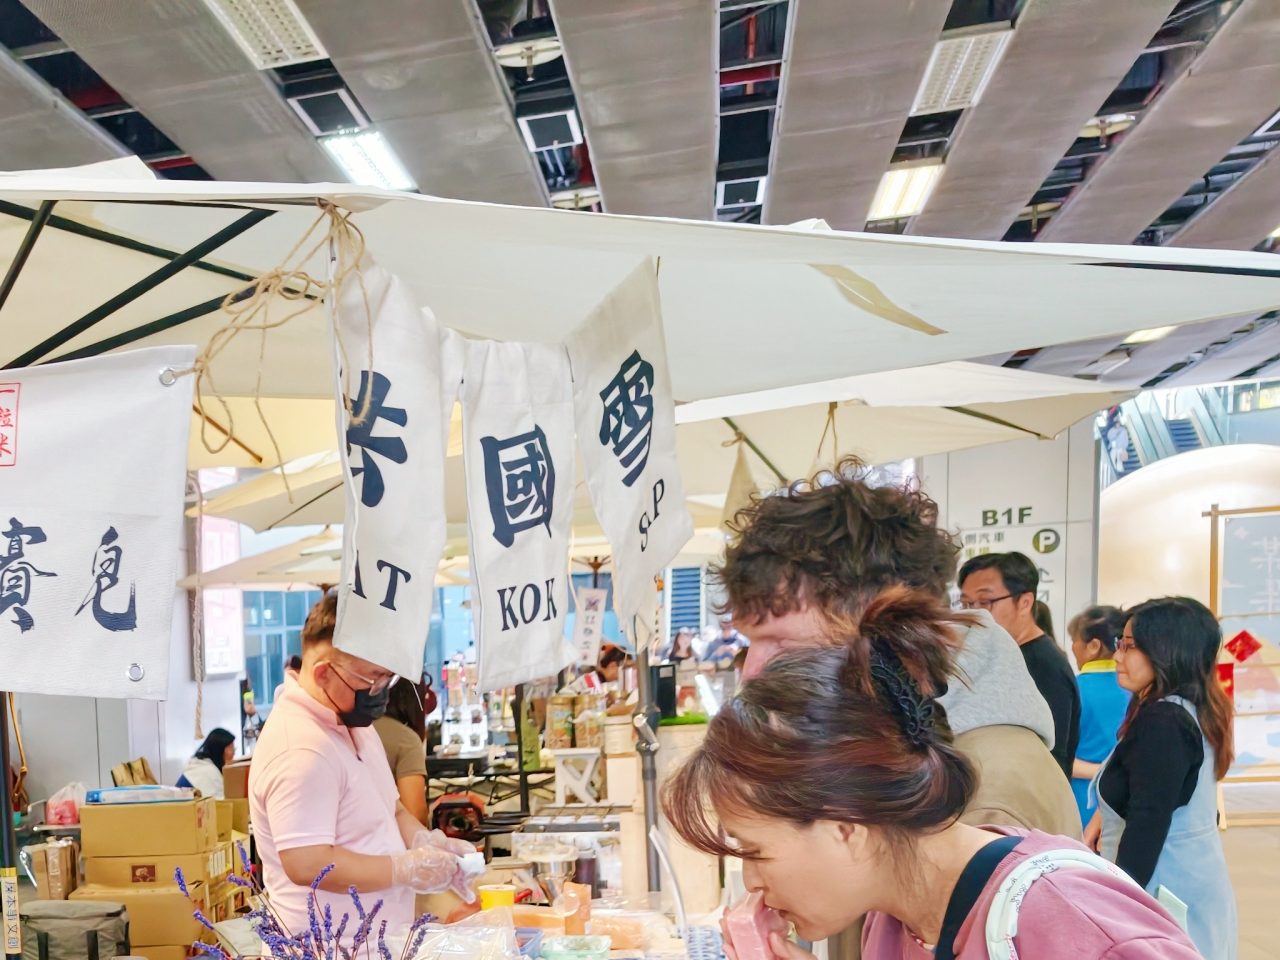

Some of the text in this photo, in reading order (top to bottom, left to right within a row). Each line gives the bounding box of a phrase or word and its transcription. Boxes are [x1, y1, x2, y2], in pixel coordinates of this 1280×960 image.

[479, 422, 557, 549] 國
[982, 506, 1033, 527] B1F
[496, 577, 558, 632] KOK
